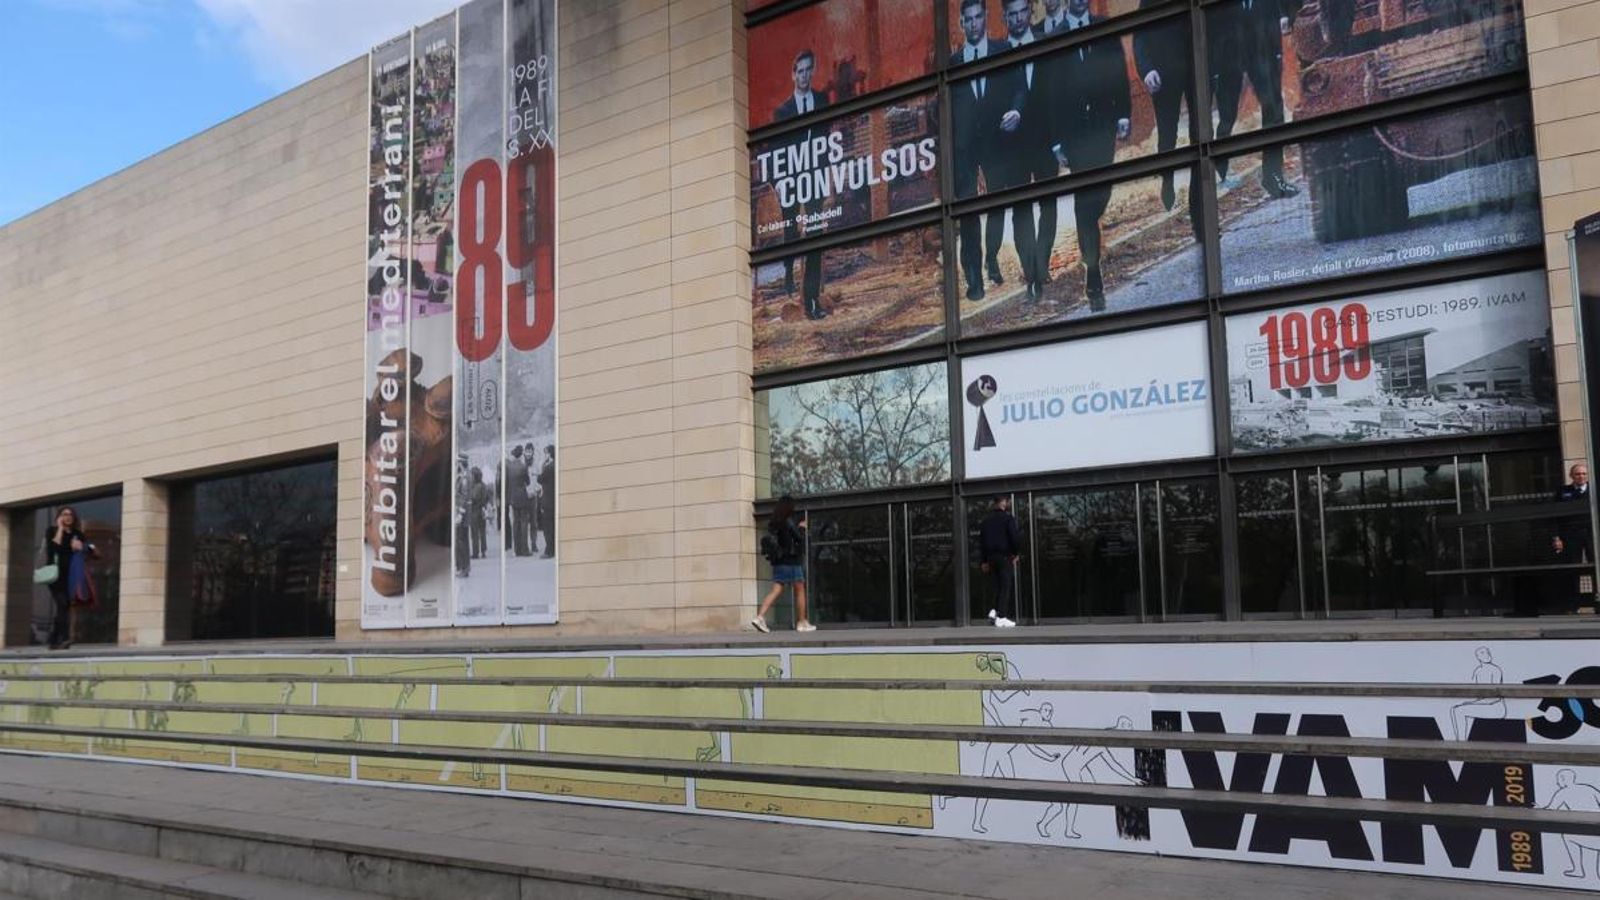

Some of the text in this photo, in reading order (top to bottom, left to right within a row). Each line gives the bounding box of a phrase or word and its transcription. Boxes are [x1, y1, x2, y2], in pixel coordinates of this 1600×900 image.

[511, 55, 548, 87] 1989
[510, 87, 531, 111] LA
[510, 107, 544, 136] DEL
[529, 127, 553, 154] XX
[757, 131, 843, 182] TEMPS
[775, 138, 936, 208] CONVULSOS
[373, 103, 402, 349] mediterrani
[456, 148, 555, 362] 89
[1234, 275, 1269, 287] Martha
[1312, 260, 1341, 274] detall
[1487, 291, 1526, 307] IVAM
[1259, 302, 1371, 390] 1989
[377, 362, 399, 402] el
[1001, 398, 1065, 425] JULIO
[1072, 379, 1207, 415] GONZÁLEZ
[373, 412, 398, 571] habitar
[1115, 710, 1544, 874] IVAM
[1504, 765, 1532, 871] 1989 2019
